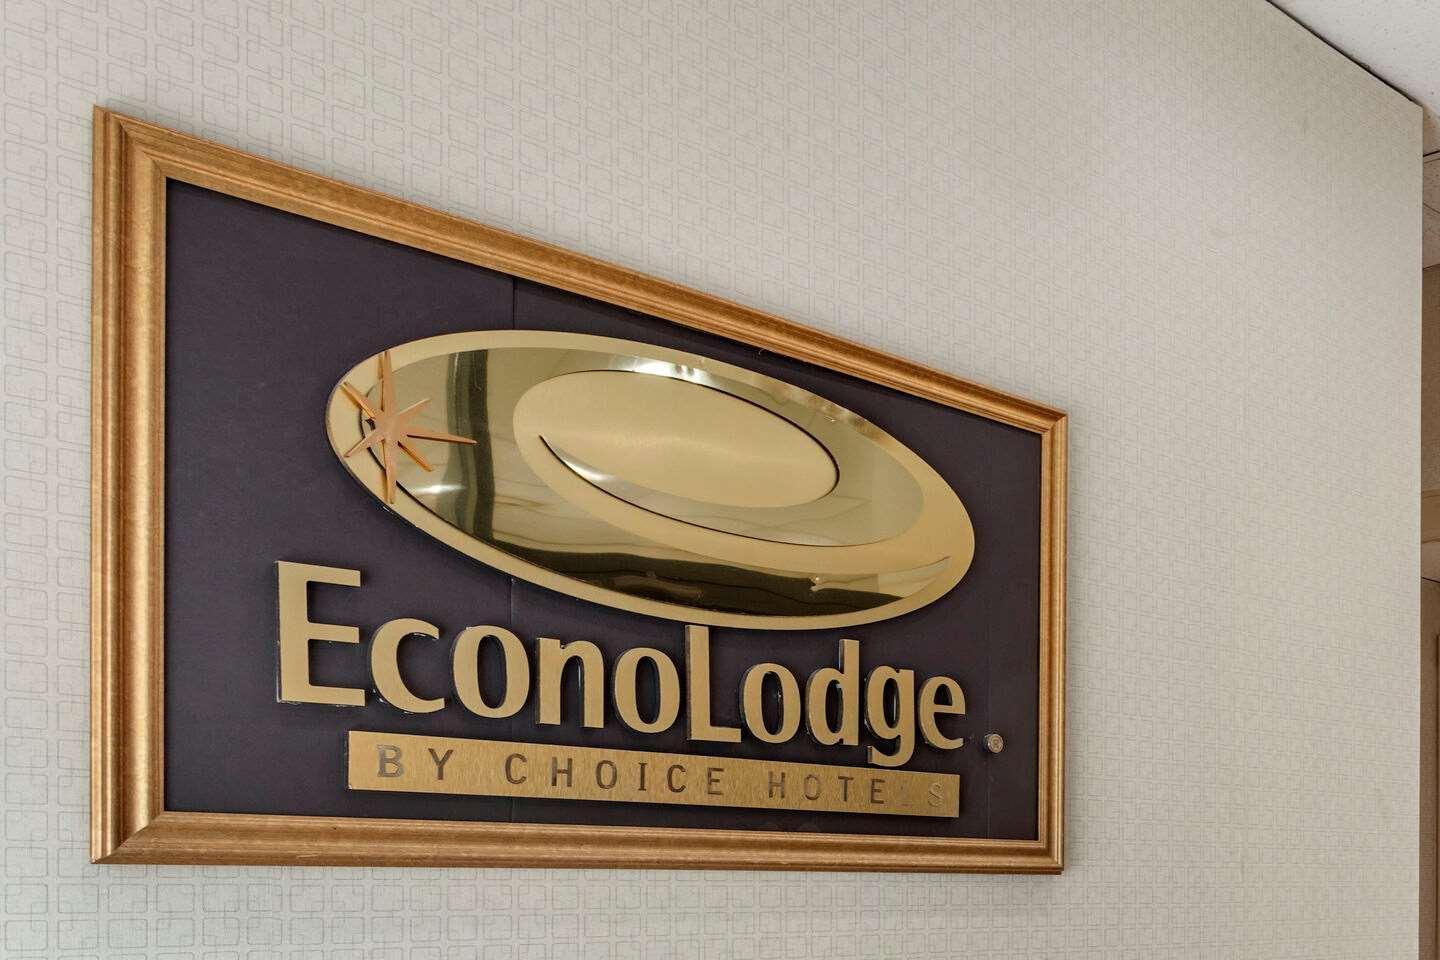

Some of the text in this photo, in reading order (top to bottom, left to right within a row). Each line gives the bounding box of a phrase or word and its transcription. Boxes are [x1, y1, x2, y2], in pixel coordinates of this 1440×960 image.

[275, 559, 966, 768] EconoLodge
[376, 743, 946, 808] BY CHOICE HOTES
